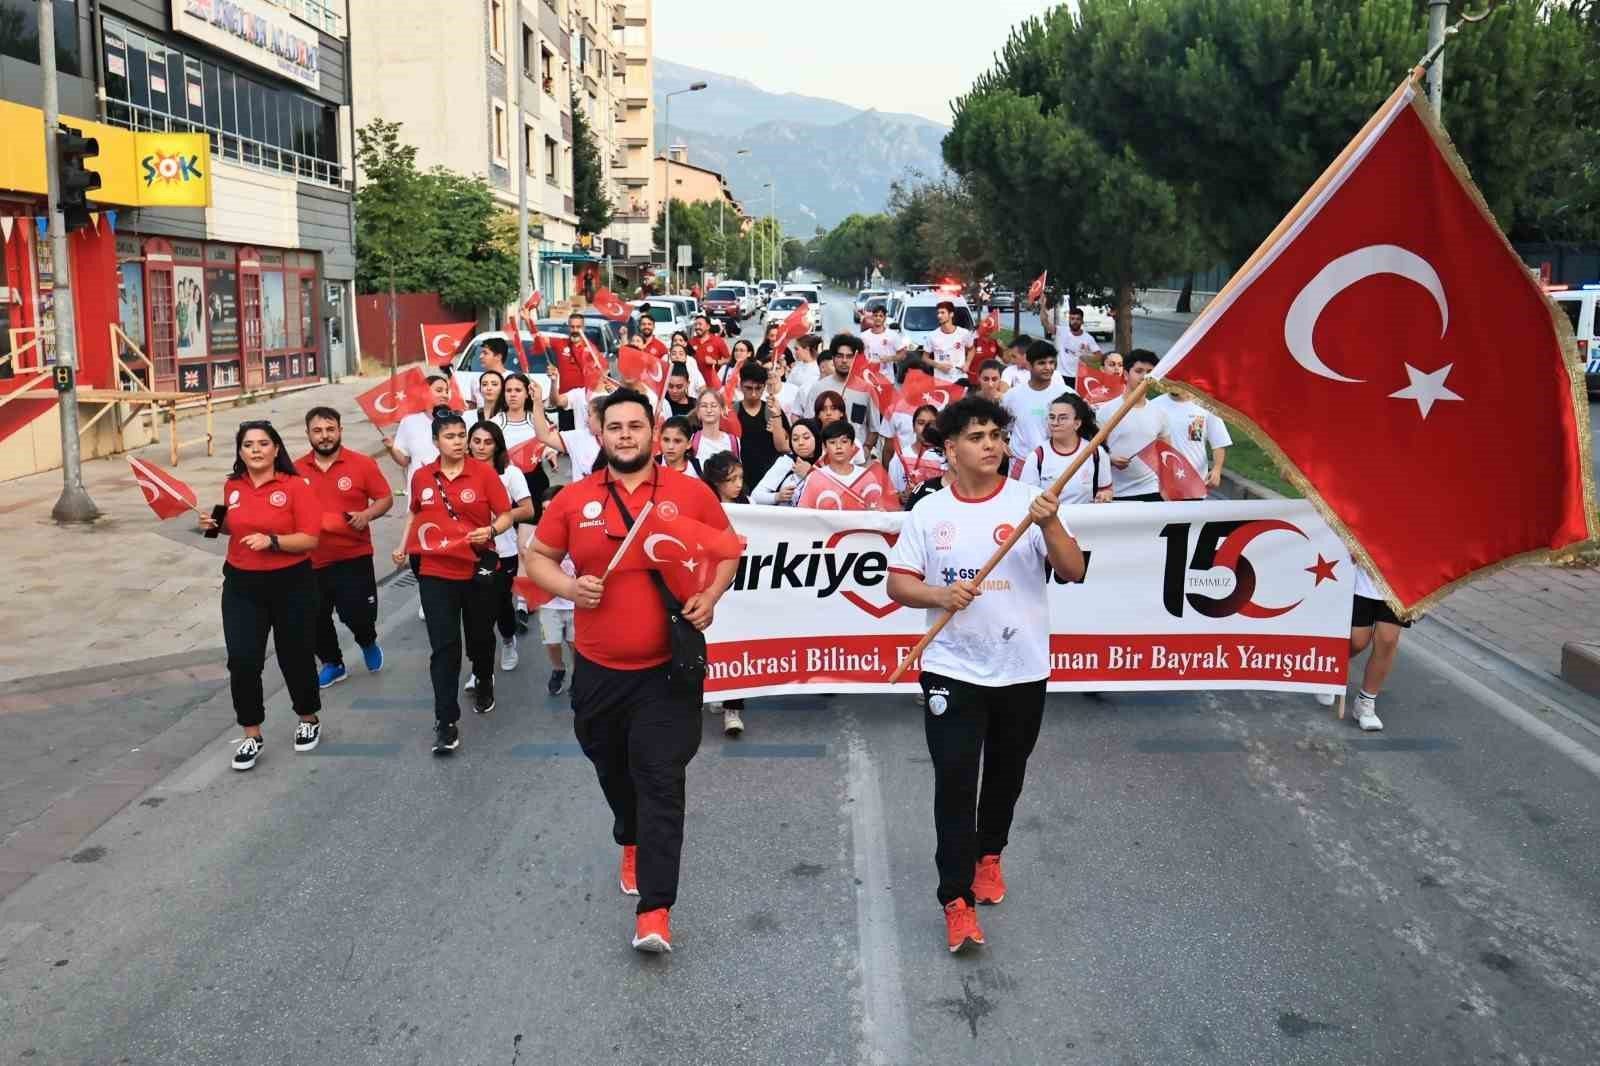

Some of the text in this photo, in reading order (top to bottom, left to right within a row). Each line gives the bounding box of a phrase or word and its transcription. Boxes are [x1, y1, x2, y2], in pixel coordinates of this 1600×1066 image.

[142, 155, 202, 187] ŞOK
[725, 541, 888, 598] rkiye
[1189, 577, 1231, 587] TEMMUZ
[705, 649, 797, 680] mokrasi
[806, 646, 887, 677] Bilinci,
[1108, 646, 1142, 670] Bir
[1151, 645, 1230, 675] Bayrak
[1237, 645, 1340, 678] Yarışıdır.
